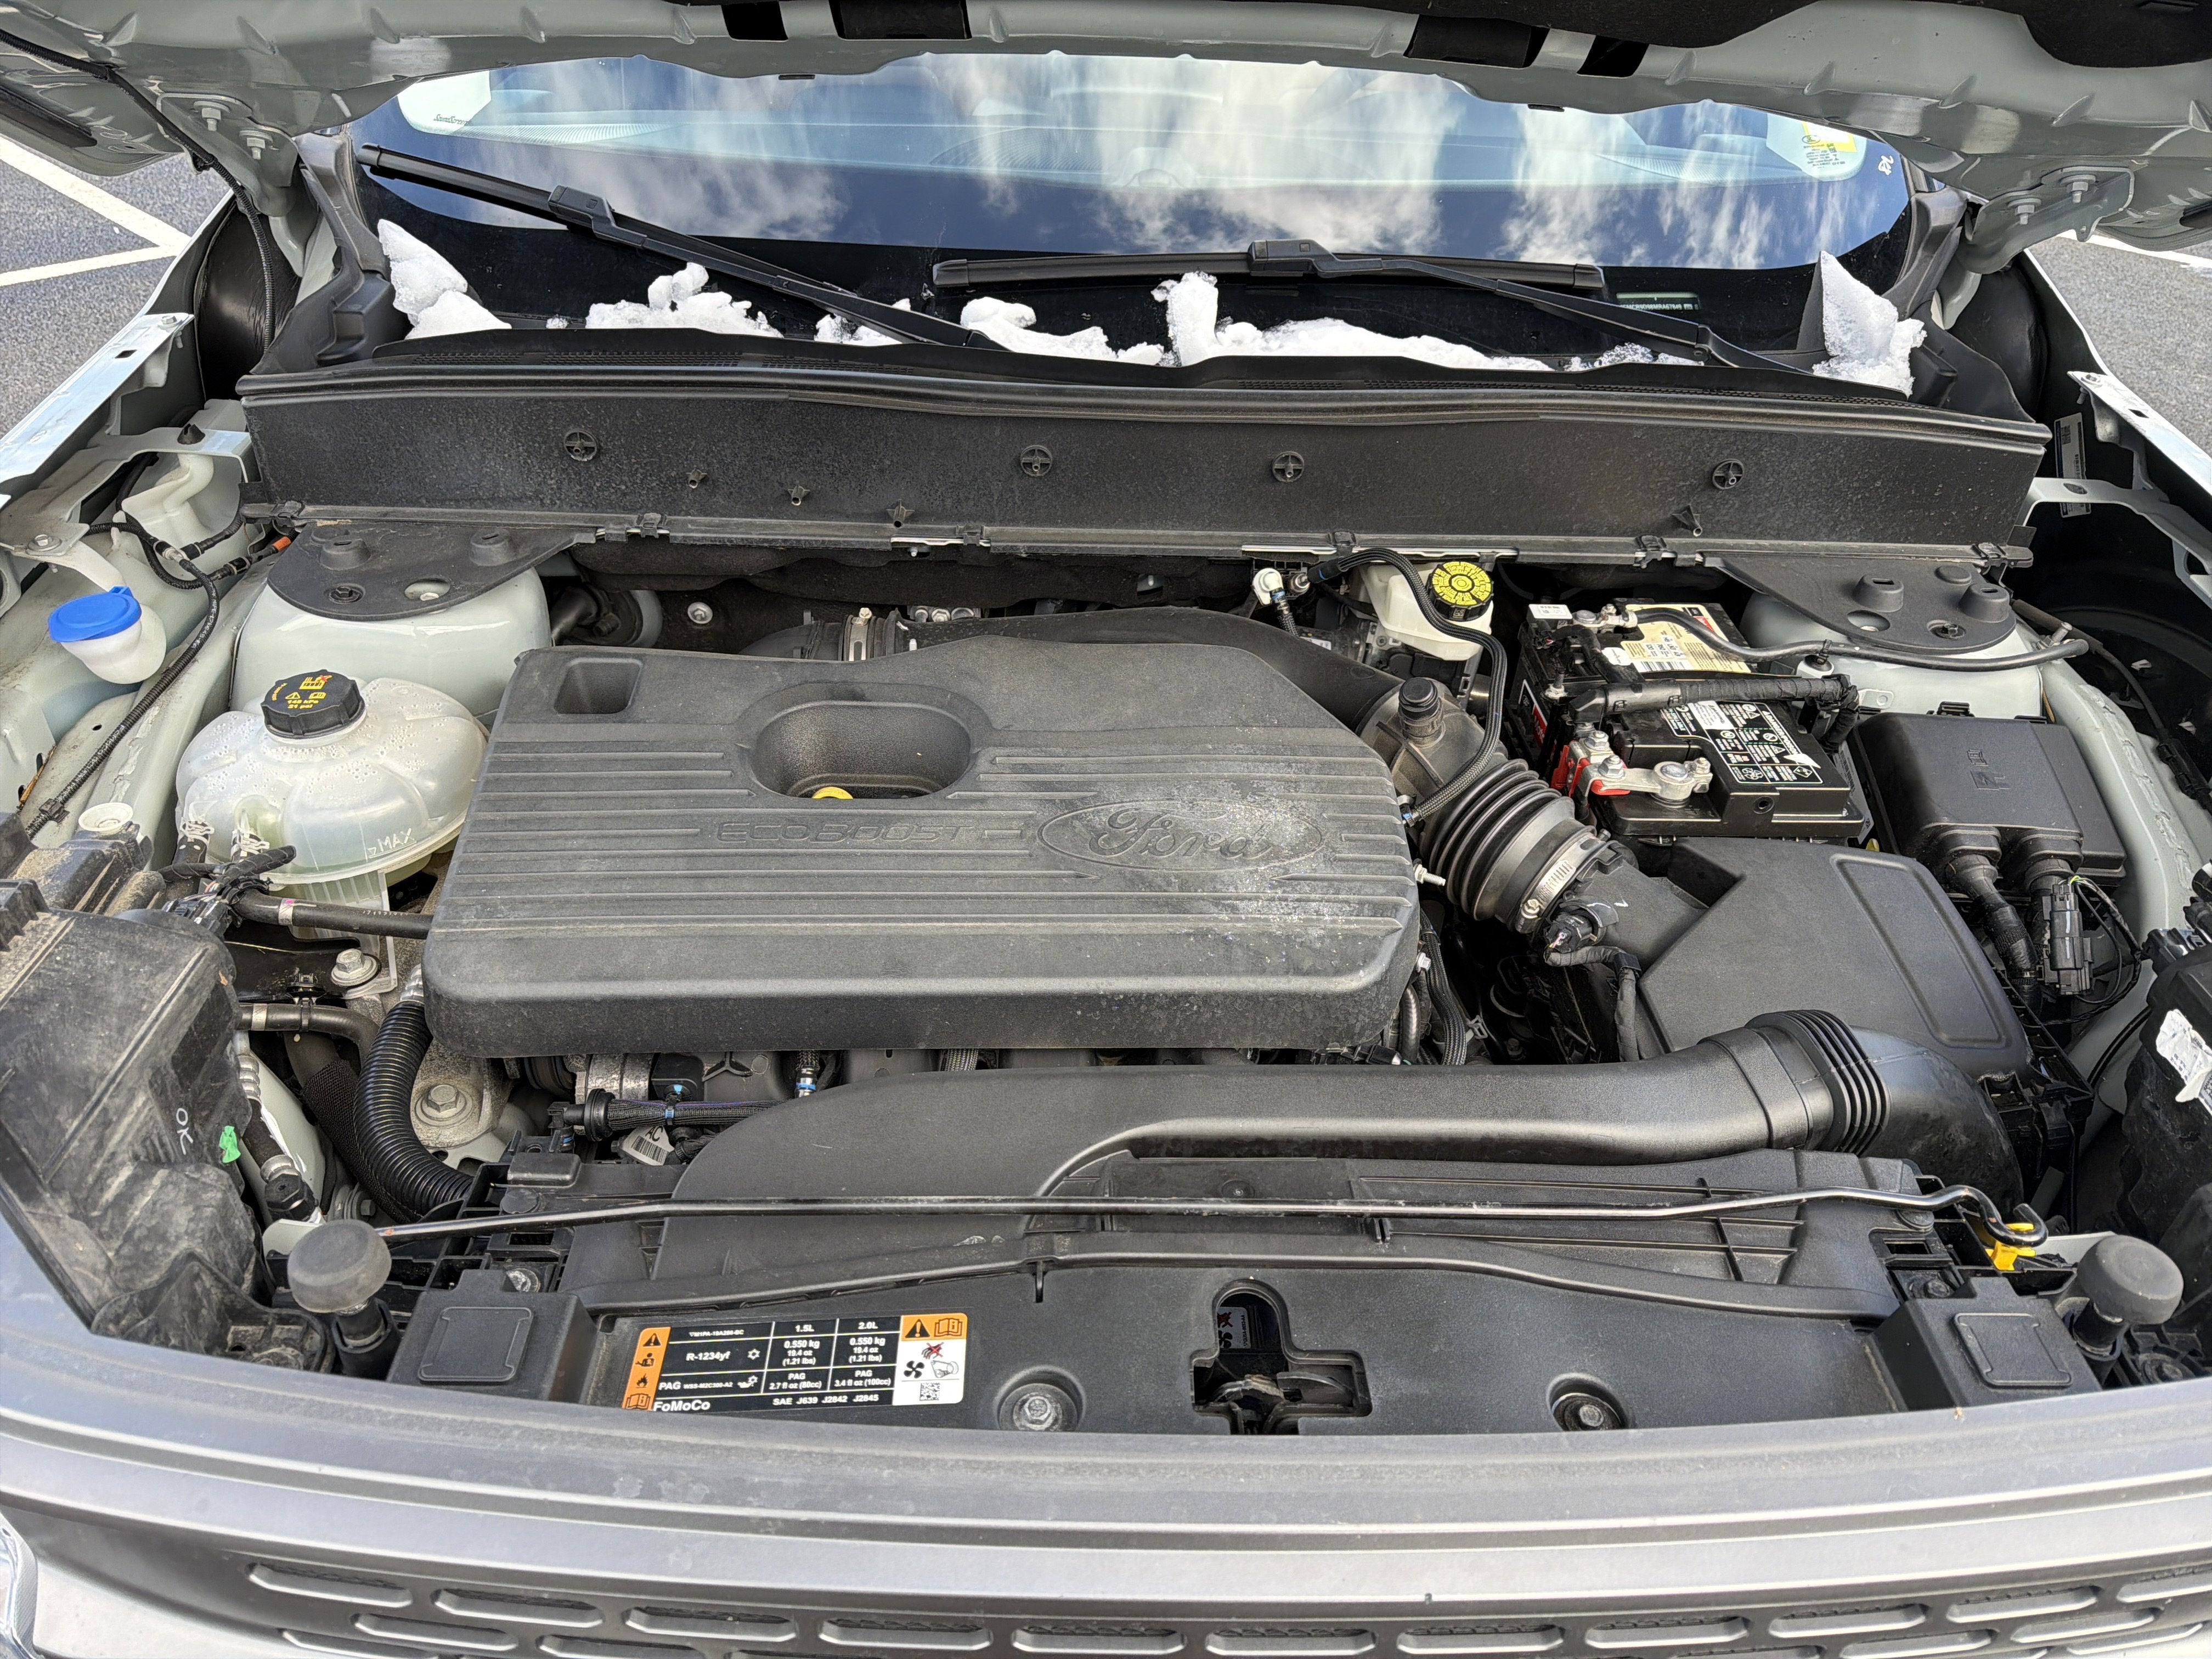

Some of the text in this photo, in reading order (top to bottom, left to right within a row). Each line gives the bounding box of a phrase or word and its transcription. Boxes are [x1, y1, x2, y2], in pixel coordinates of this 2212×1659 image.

[377, 827, 415, 852] MAX
[1089, 808, 1274, 860] Ford
[176, 1108, 194, 1155] OK
[645, 1125, 663, 1142] AC
[784, 1340, 820, 1349] 0.550 kg
[849, 1336, 885, 1346] 0.550 kg
[686, 1351, 731, 1361] R-1234yf
[658, 1381, 681, 1390] PAG
[653, 1400, 710, 1412] FoMoCo
